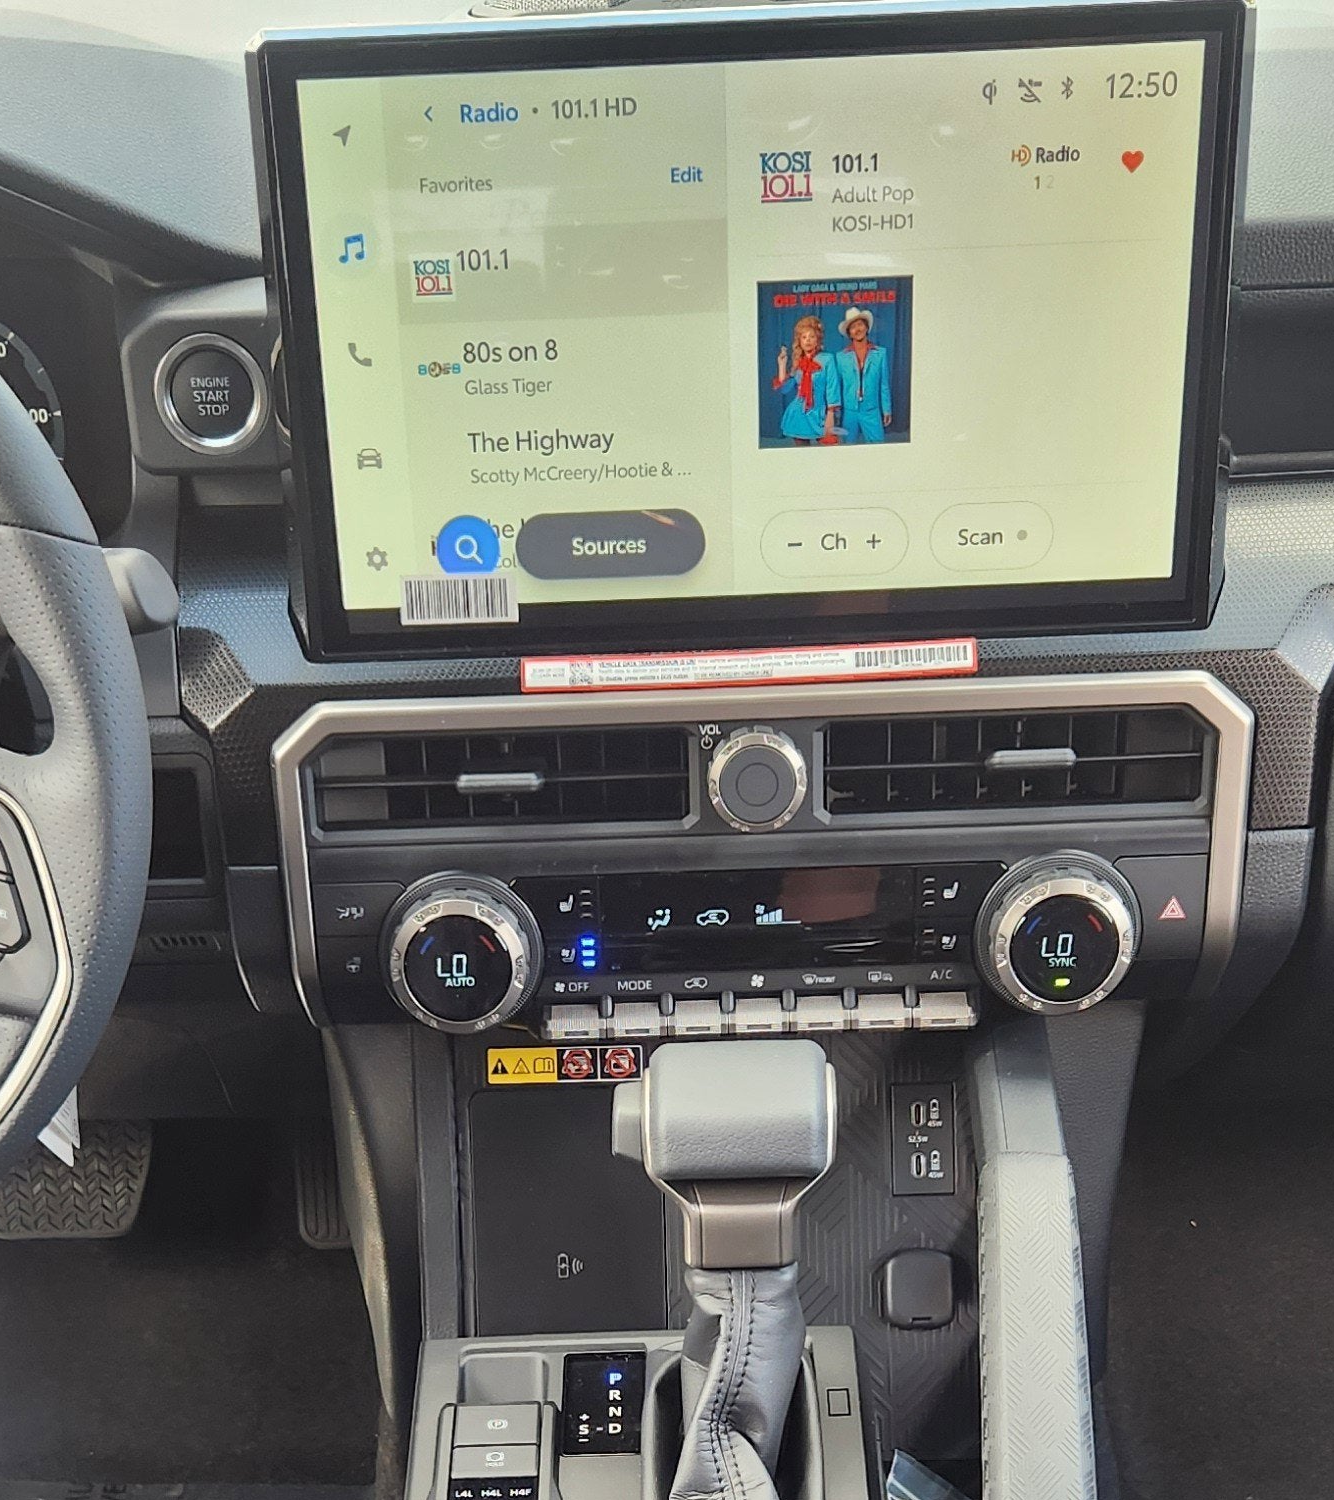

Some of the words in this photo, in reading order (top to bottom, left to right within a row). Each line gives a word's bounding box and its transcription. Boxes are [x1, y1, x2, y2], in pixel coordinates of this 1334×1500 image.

[1105, 71, 1178, 99] 12:50
[460, 102, 519, 123] Radio
[551, 99, 599, 120] 101.1
[604, 97, 637, 118] HD
[759, 151, 812, 173] KOSI
[1036, 145, 1080, 164] Radio
[832, 153, 879, 174] 101.1
[670, 167, 703, 184] Edit
[419, 176, 493, 195] Favorites
[761, 174, 812, 199] 101.1
[832, 185, 878, 204] Adult
[882, 184, 914, 206] Pop
[832, 214, 914, 232] KOSI-HD1
[413, 260, 450, 275] KOSI
[456, 249, 510, 272] 101.1
[416, 276, 453, 293] 101.1
[463, 342, 503, 364] 80s
[508, 345, 538, 361] on
[545, 339, 559, 360] 8
[190, 377, 229, 387] ENGINE
[465, 379, 508, 395] Glass
[512, 378, 553, 397] Tiger
[193, 390, 229, 402] START
[198, 404, 229, 416] STOP
[468, 432, 510, 454] The
[516, 430, 614, 456] Highway
[470, 468, 520, 486] Scotty
[524, 463, 658, 484] McCreery/Hootie
[661, 463, 674, 477] &
[572, 537, 646, 555] Sources
[821, 532, 847, 550] Ch
[958, 529, 1003, 546] Scan
[699, 724, 721, 735] VOL
[1048, 957, 1076, 968] SYNC
[446, 977, 475, 988] AUTO
[930, 969, 953, 980] A/C
[569, 982, 590, 993] OFF
[617, 980, 652, 991] MODE
[610, 1373, 622, 1384] P
[609, 1390, 621, 1400] R
[609, 1407, 621, 1417] N
[578, 1424, 589, 1435] S
[608, 1423, 621, 1434] D
[455, 1490, 473, 1498] L4L
[481, 1488, 502, 1498] H4L
[510, 1488, 532, 1497] H4F
